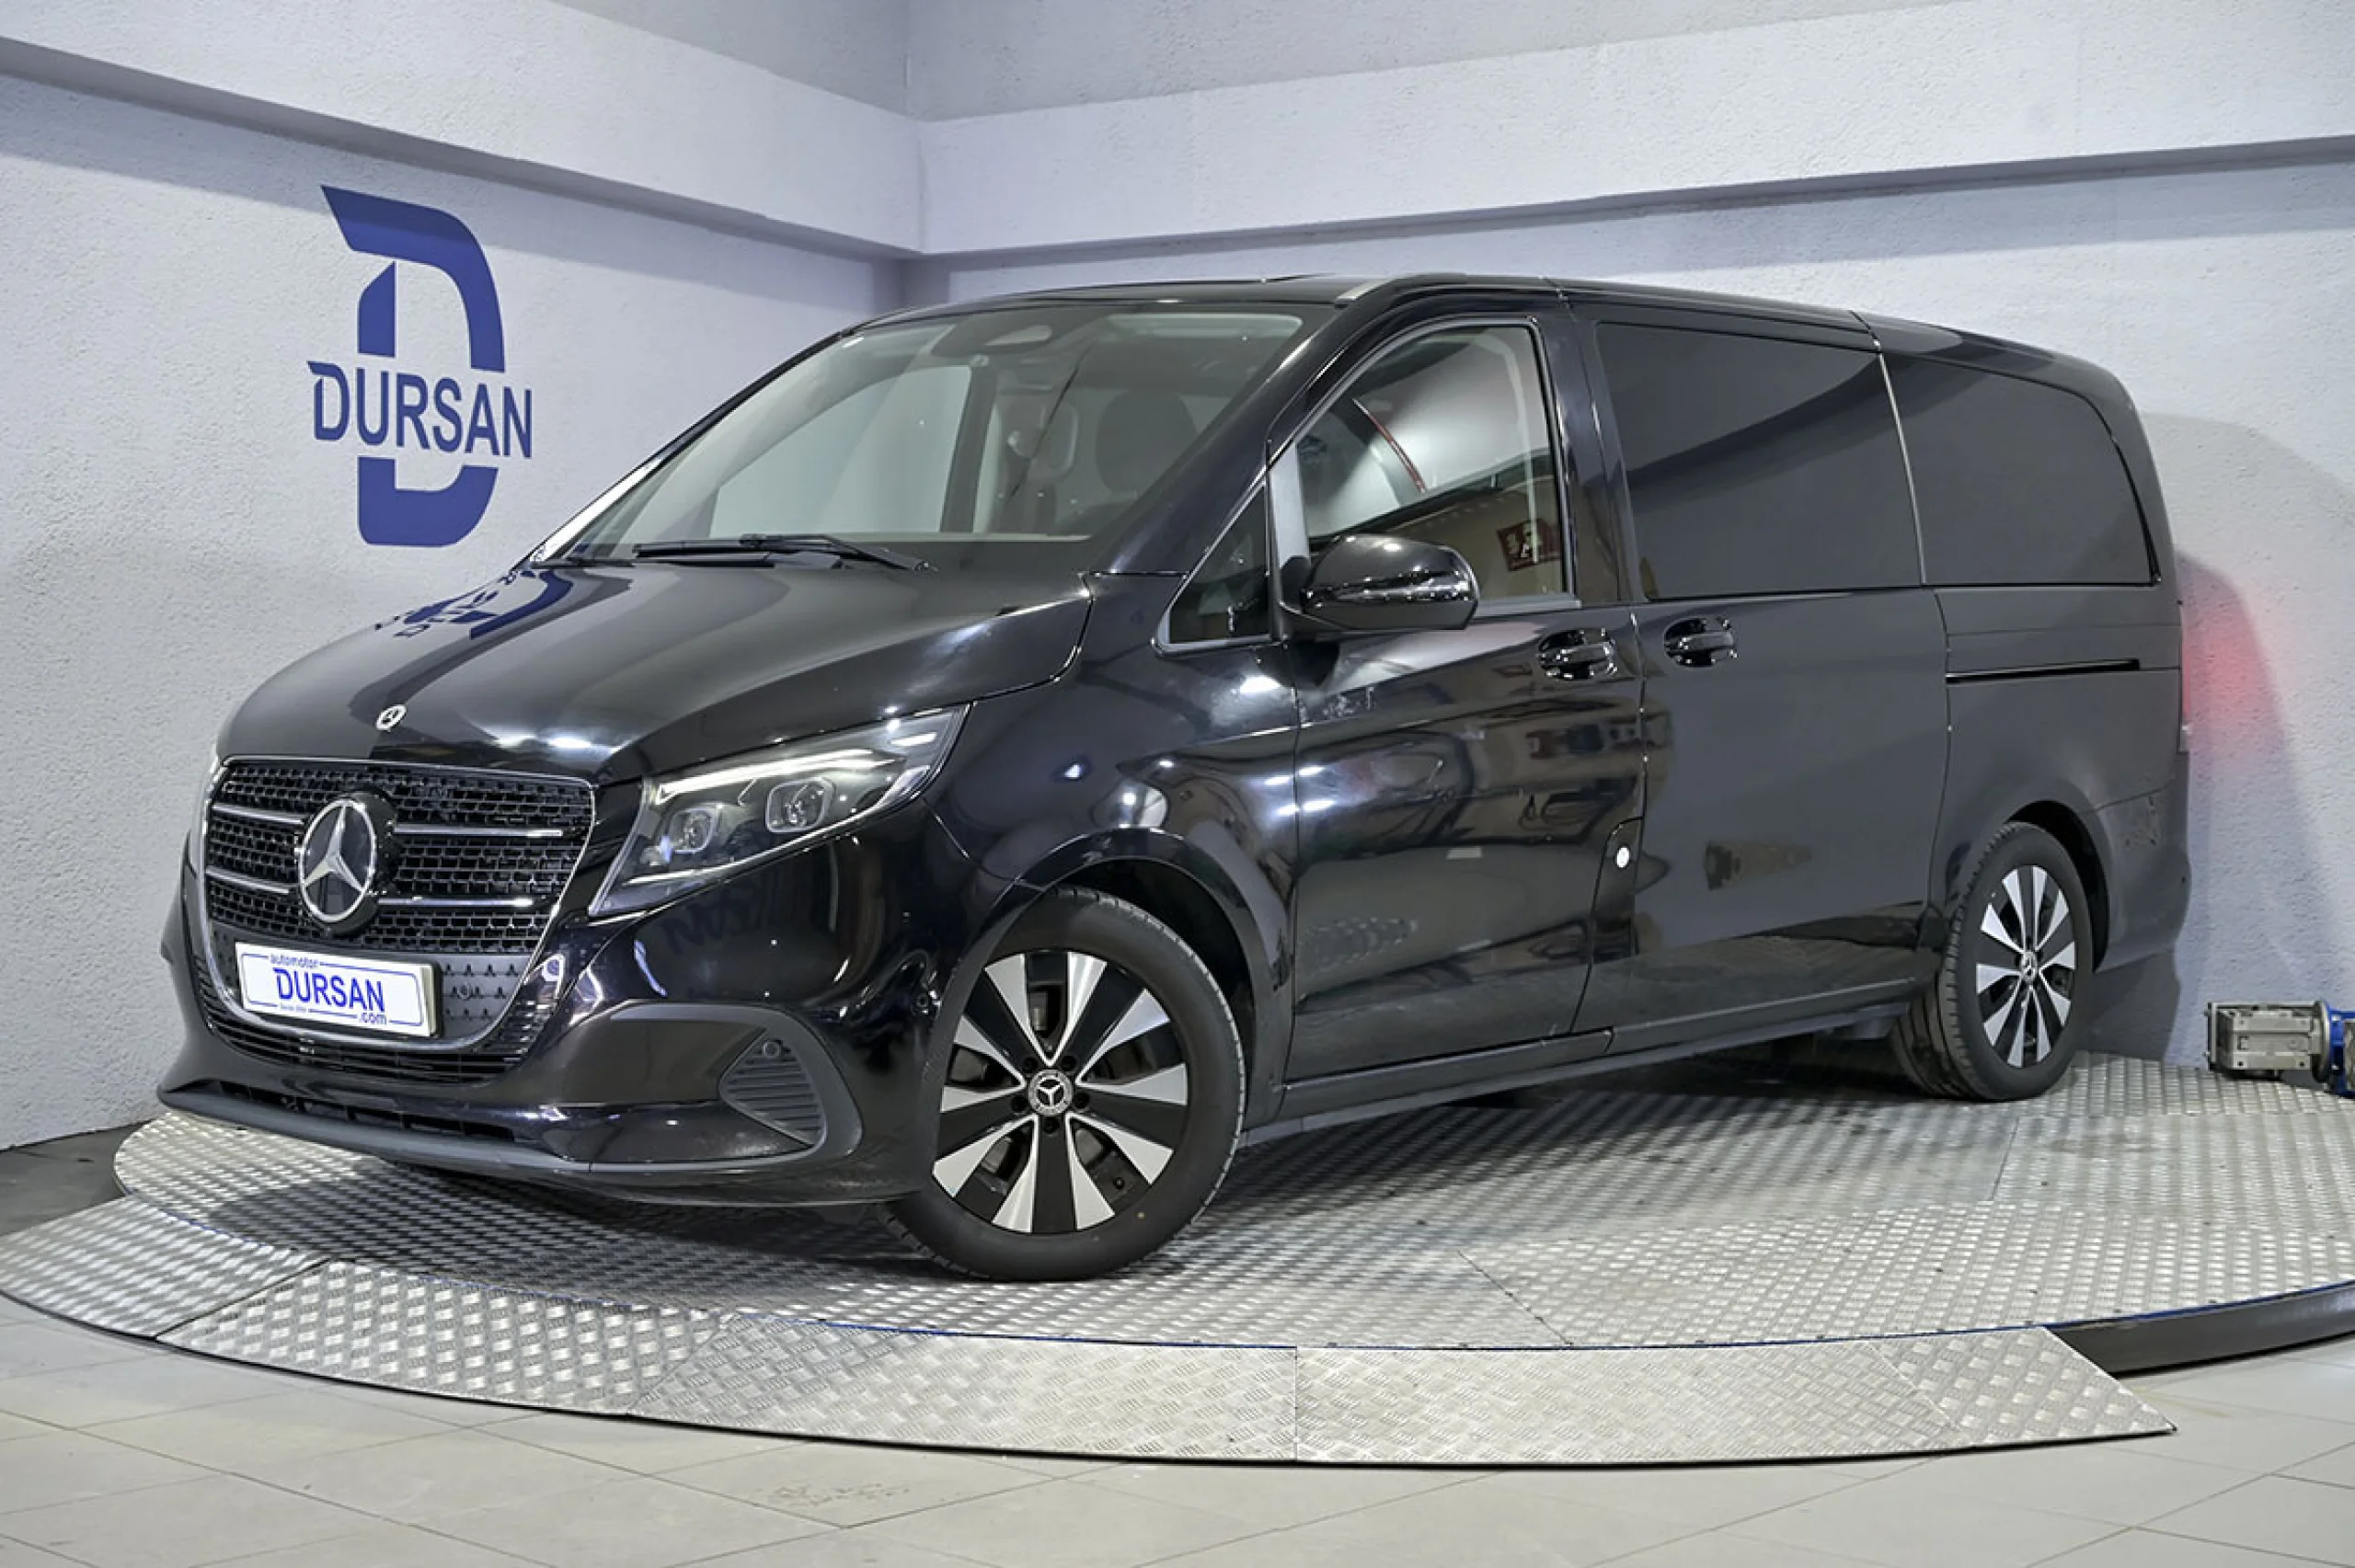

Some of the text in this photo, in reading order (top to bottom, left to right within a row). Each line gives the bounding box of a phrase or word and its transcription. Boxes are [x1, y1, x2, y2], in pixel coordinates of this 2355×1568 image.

[306, 360, 533, 459] DURSAN
[270, 953, 320, 969] automotor
[273, 967, 385, 1013] DURSAN
[359, 1012, 387, 1025] .com
